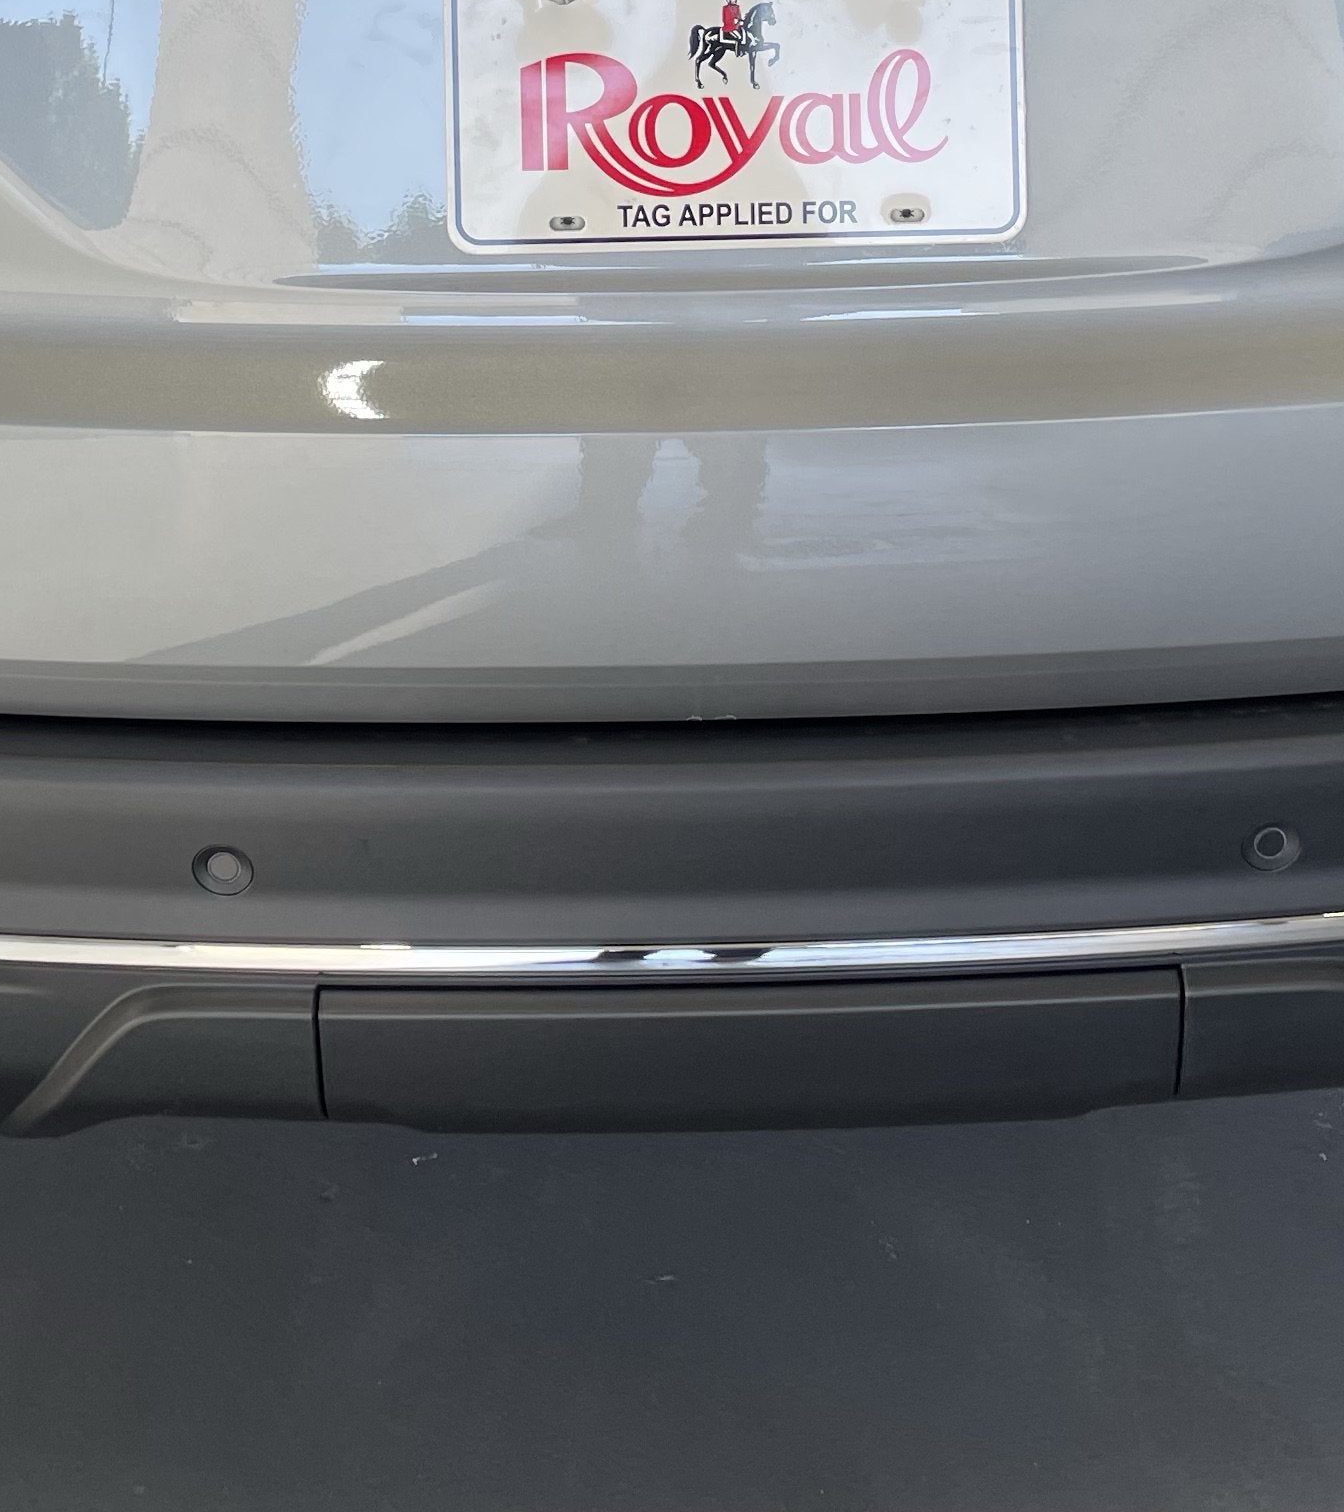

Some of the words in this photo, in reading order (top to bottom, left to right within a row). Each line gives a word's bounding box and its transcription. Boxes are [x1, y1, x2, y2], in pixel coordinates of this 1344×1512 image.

[519, 48, 949, 198] Royal
[616, 204, 671, 228] TAG
[678, 202, 793, 227] APPLIED
[802, 200, 859, 225] FOR
